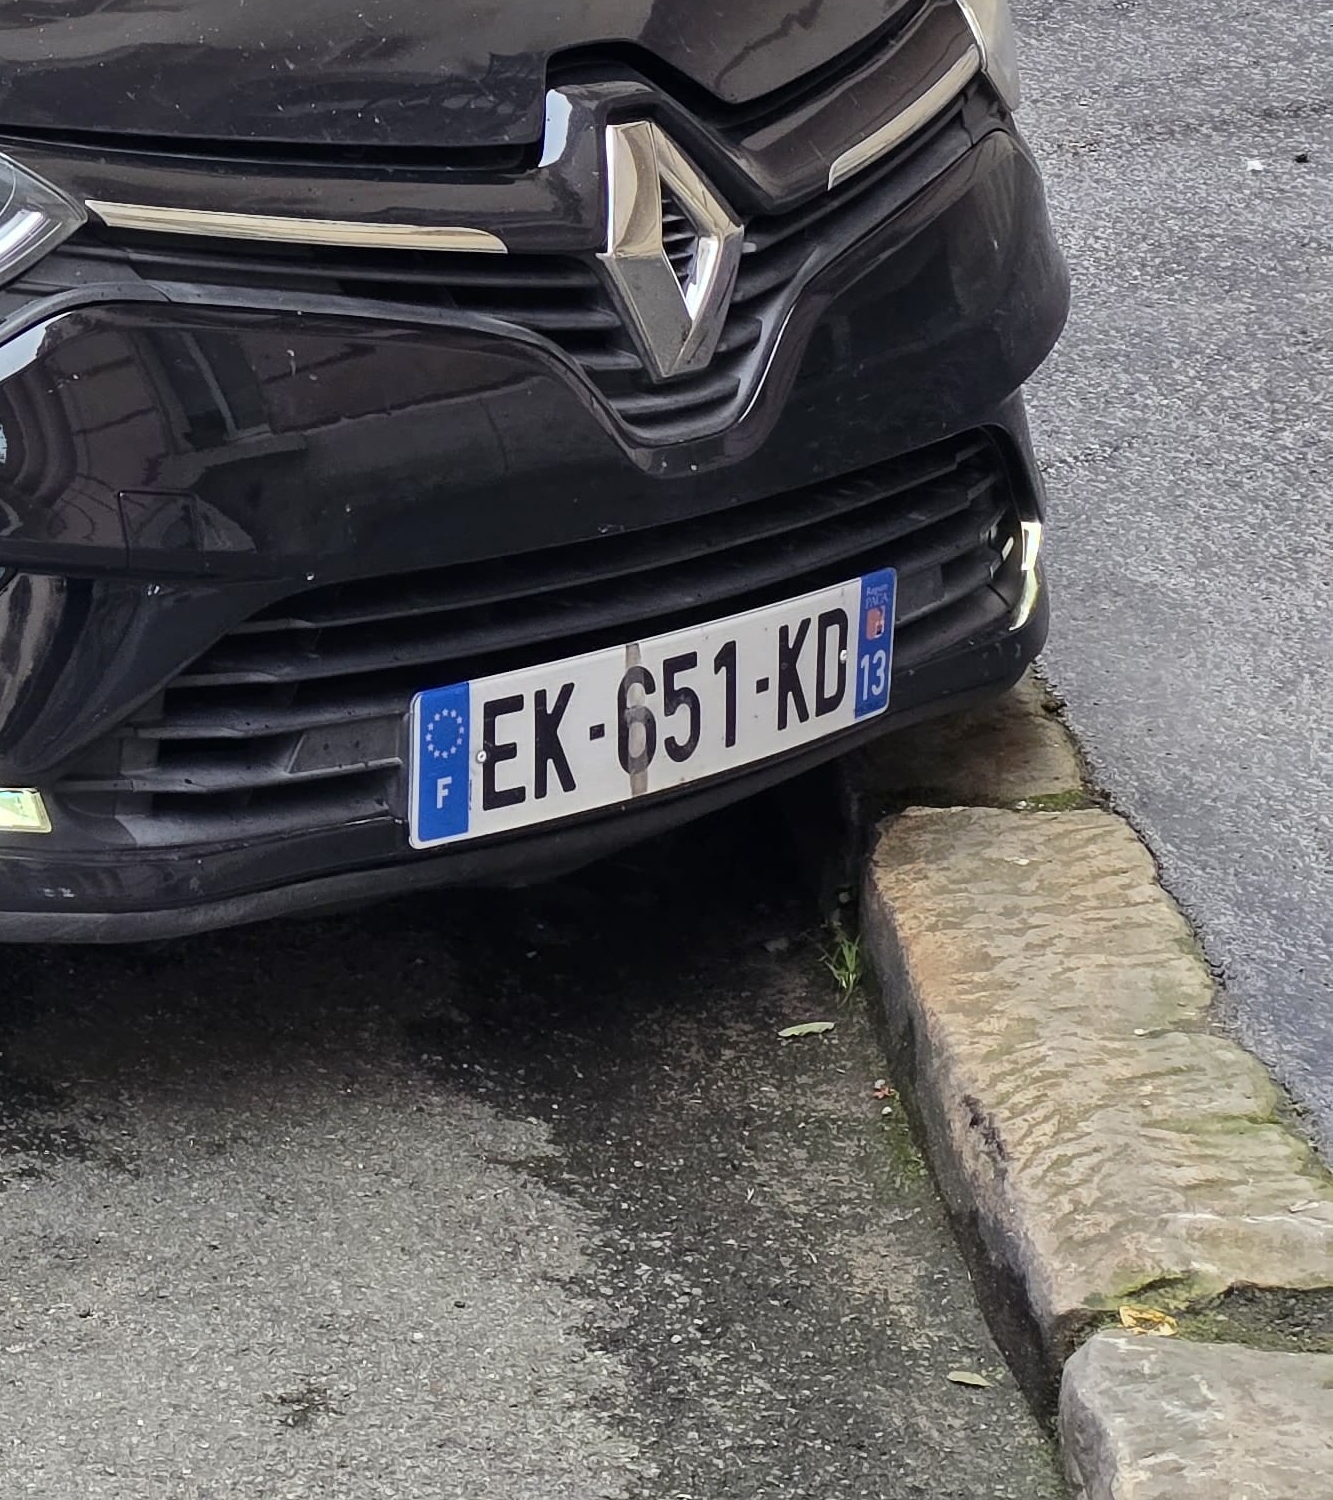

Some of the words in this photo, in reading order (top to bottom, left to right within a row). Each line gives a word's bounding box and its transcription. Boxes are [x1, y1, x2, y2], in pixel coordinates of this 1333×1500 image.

[861, 649, 886, 701] 13
[482, 607, 849, 811] EK-651-KD
[436, 776, 452, 809] F
